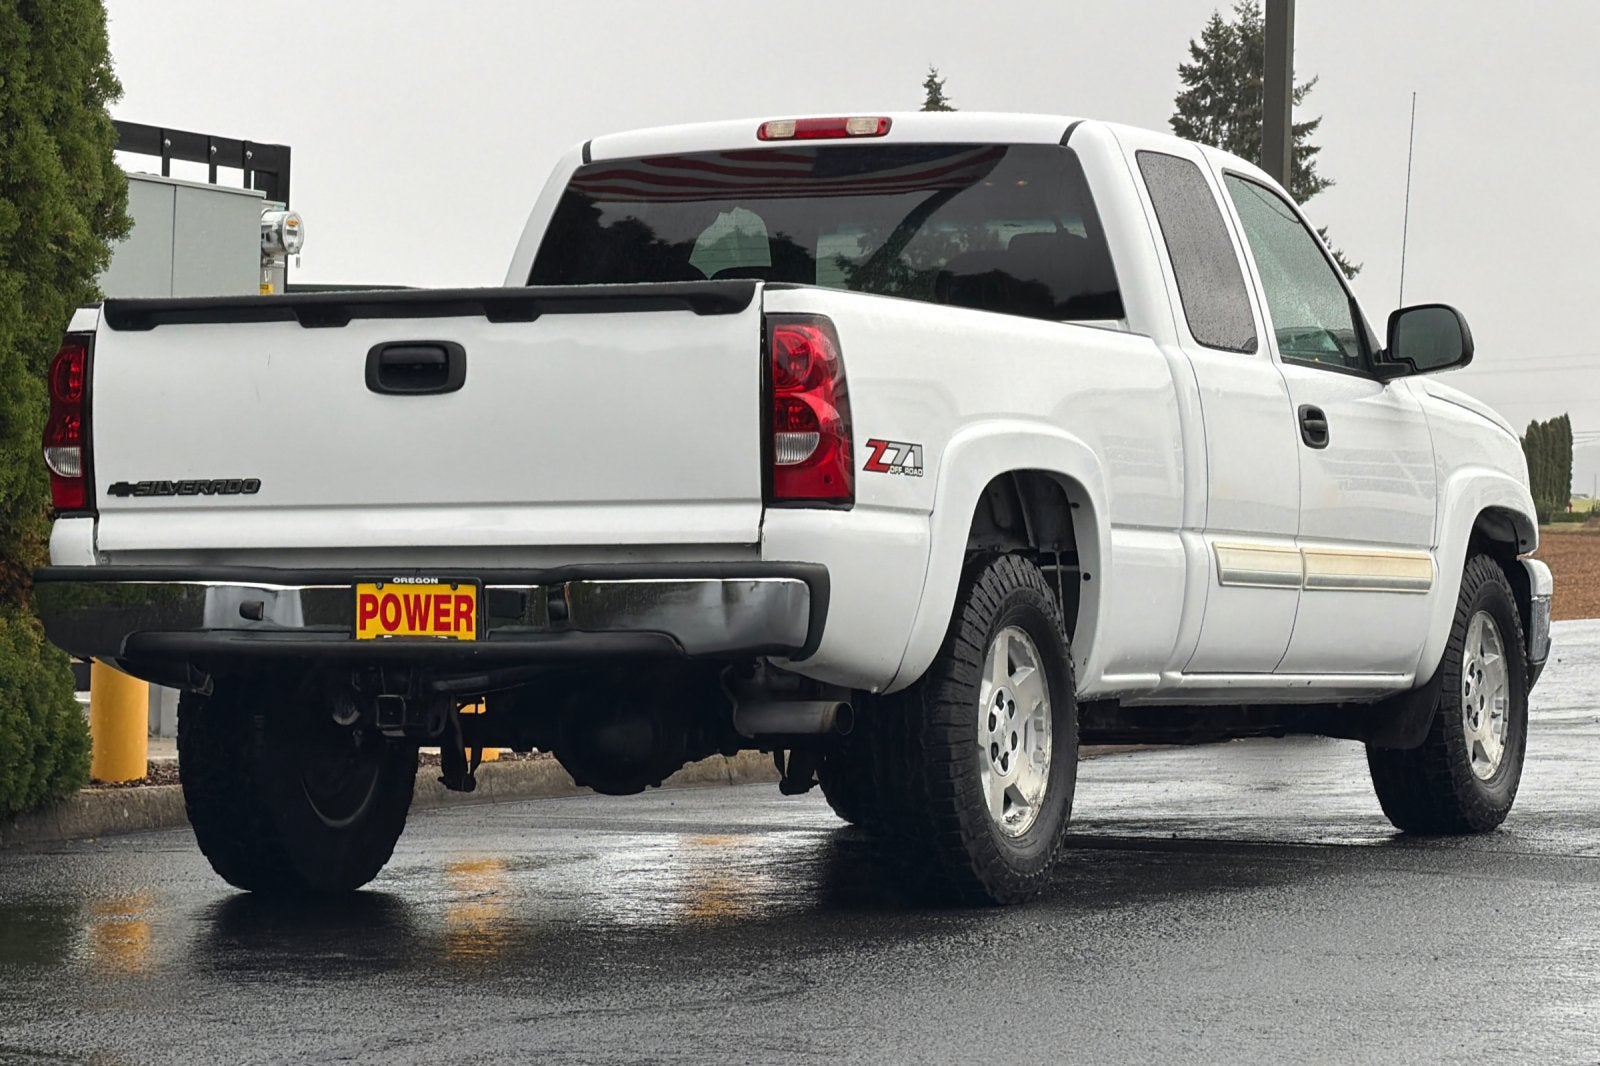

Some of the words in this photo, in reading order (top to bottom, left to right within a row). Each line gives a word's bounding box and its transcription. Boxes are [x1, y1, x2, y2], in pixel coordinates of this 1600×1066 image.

[863, 438, 923, 473] Z71
[890, 466, 903, 474] OFF
[904, 467, 923, 477] ROAD
[133, 478, 261, 496] SILVERADO
[360, 593, 474, 632] POWER
